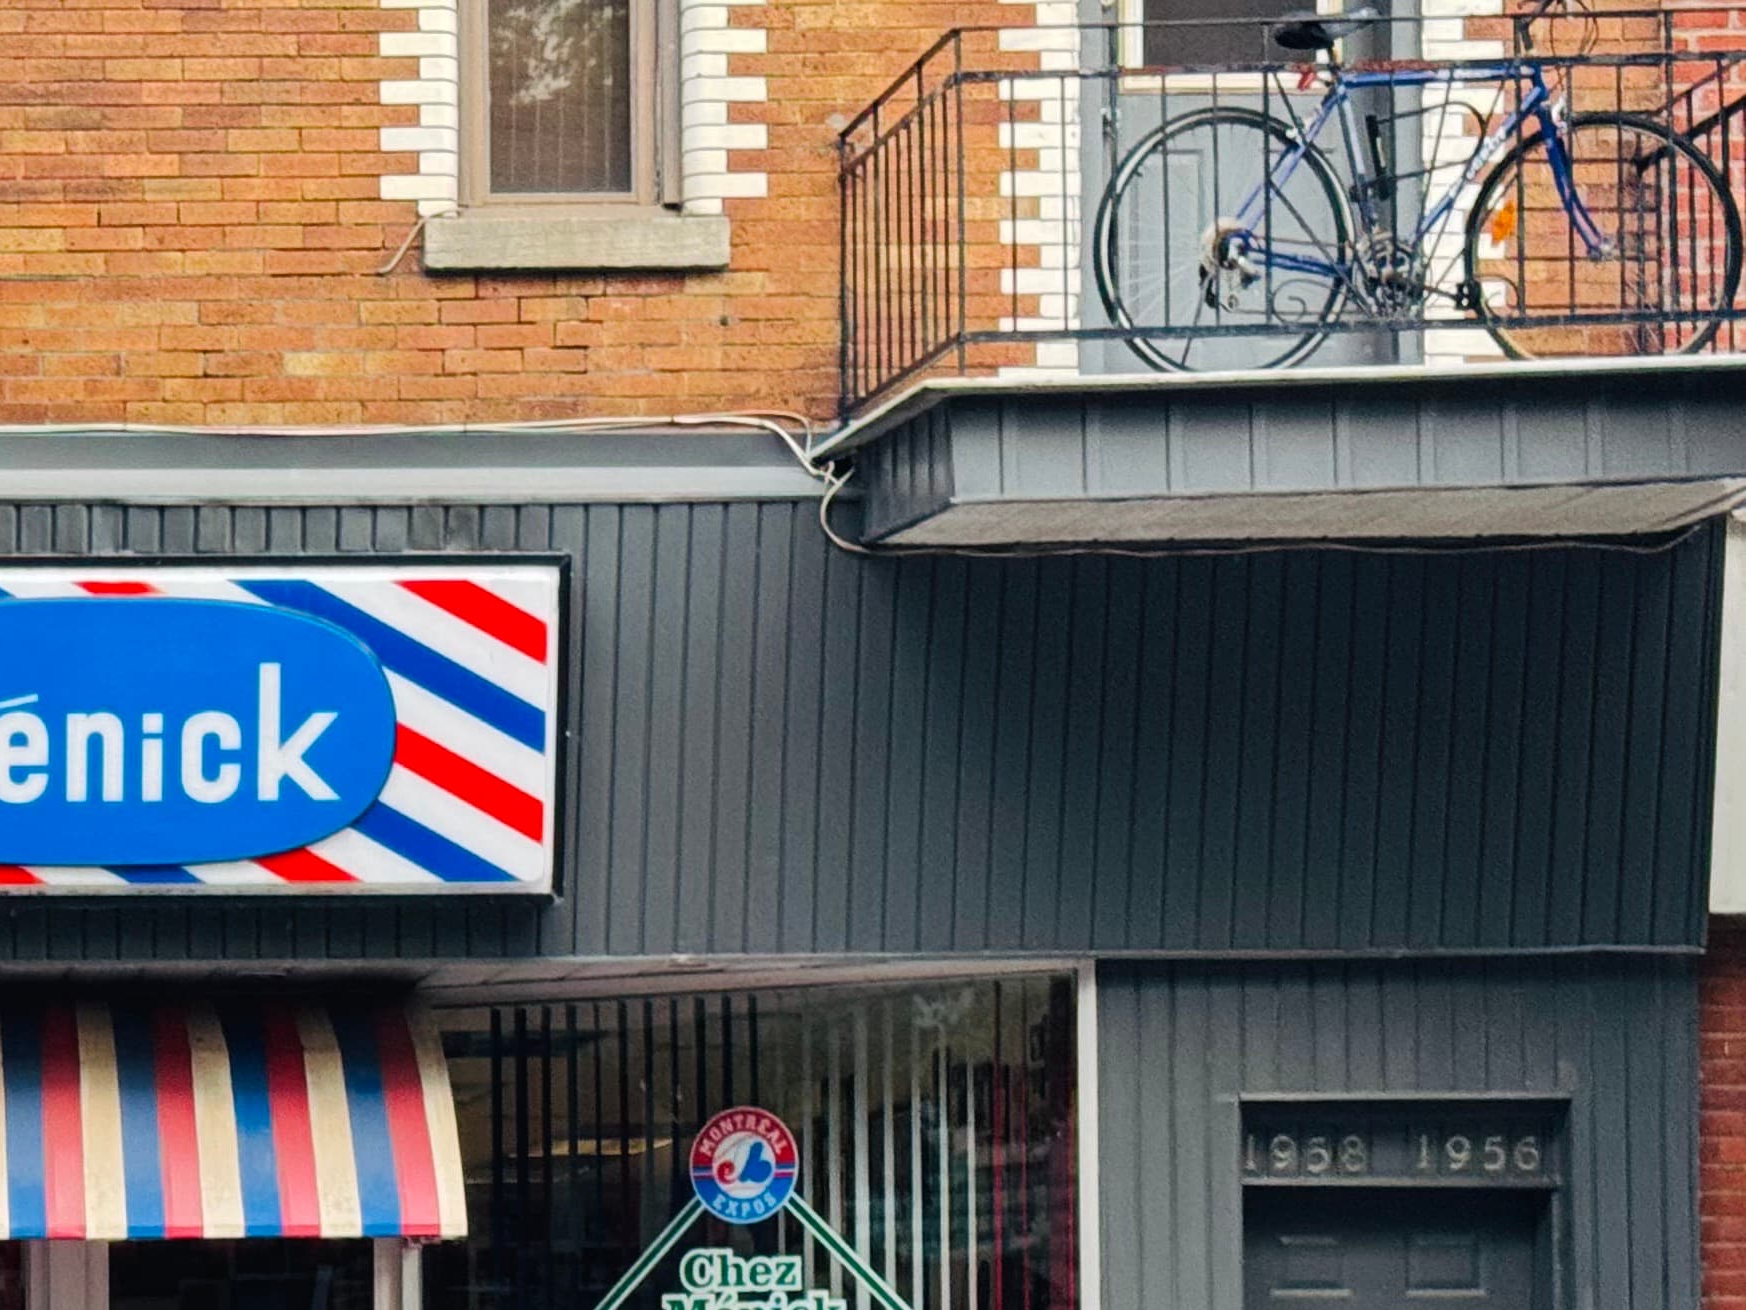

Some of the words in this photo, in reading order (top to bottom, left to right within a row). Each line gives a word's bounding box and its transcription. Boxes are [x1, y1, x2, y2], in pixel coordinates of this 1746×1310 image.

[699, 1113, 789, 1158] MONTREAL
[1417, 1134, 1540, 1171] 1956
[713, 1192, 776, 1217] EXPOS
[684, 1253, 797, 1289] Chez
